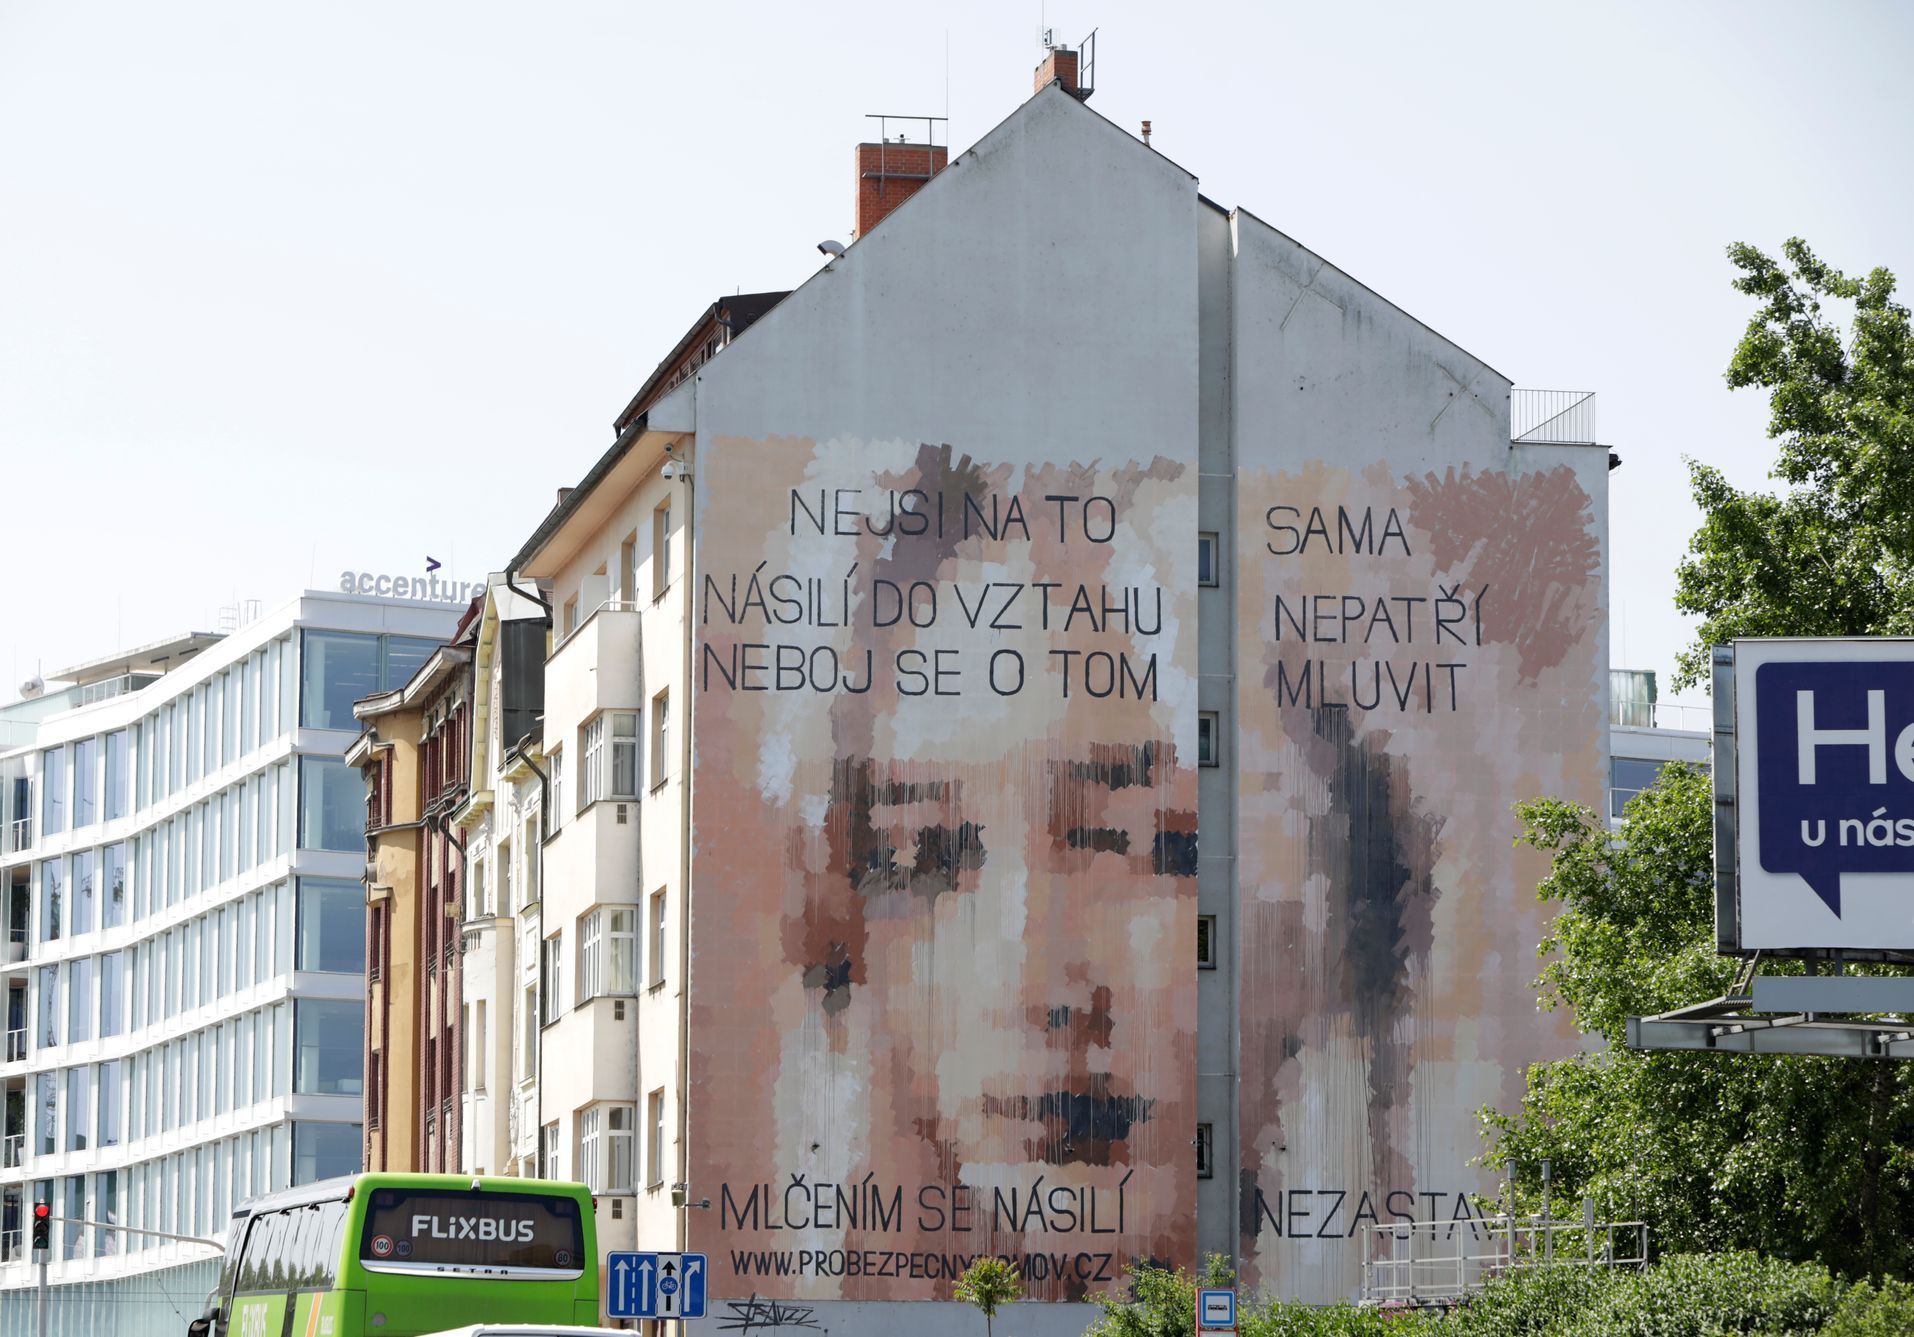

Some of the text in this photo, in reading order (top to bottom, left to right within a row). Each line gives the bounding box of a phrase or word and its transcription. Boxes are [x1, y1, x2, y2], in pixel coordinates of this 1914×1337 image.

[790, 488, 1411, 556] NEJSI NA TO SAMA
[340, 570, 487, 601] accenture
[702, 560, 1490, 647] NÁSILÍ DO VZTAHU NEPATŘÍ
[703, 642, 1467, 714] NEBOJ SE O TOM MLUVIT
[1800, 806, 1914, 848] u nás
[720, 1171, 903, 1233] MLČENÍM
[918, 1184, 972, 1233] SE
[994, 1169, 1134, 1235] NÁSILÍ
[376, 1240, 389, 1251] 100
